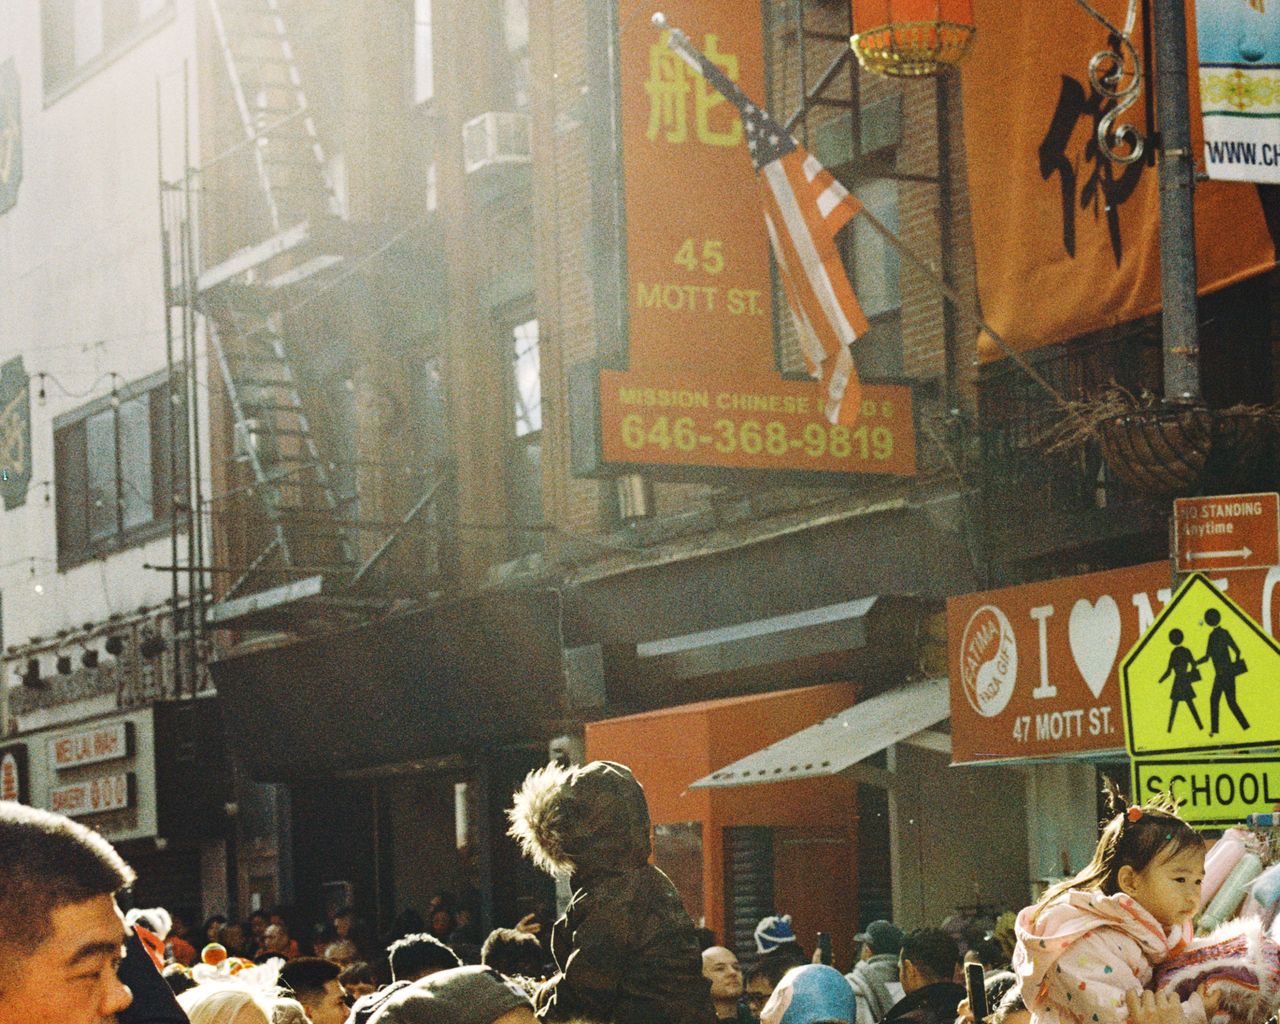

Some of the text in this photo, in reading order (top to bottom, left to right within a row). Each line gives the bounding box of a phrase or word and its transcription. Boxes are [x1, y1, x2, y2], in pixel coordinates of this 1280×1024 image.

[673, 239, 725, 273] 45
[636, 281, 764, 315] MOTT ST.
[619, 387, 709, 408] MISSION
[717, 391, 809, 414] CHINESE
[621, 413, 894, 460] 646-368-9819
[1201, 502, 1262, 518] STANDING
[1183, 522, 1233, 537] Anytime
[1030, 604, 1057, 699] I
[1013, 706, 1115, 742] 47 MOTT ST.
[1146, 773, 1280, 807] SCHOOL
